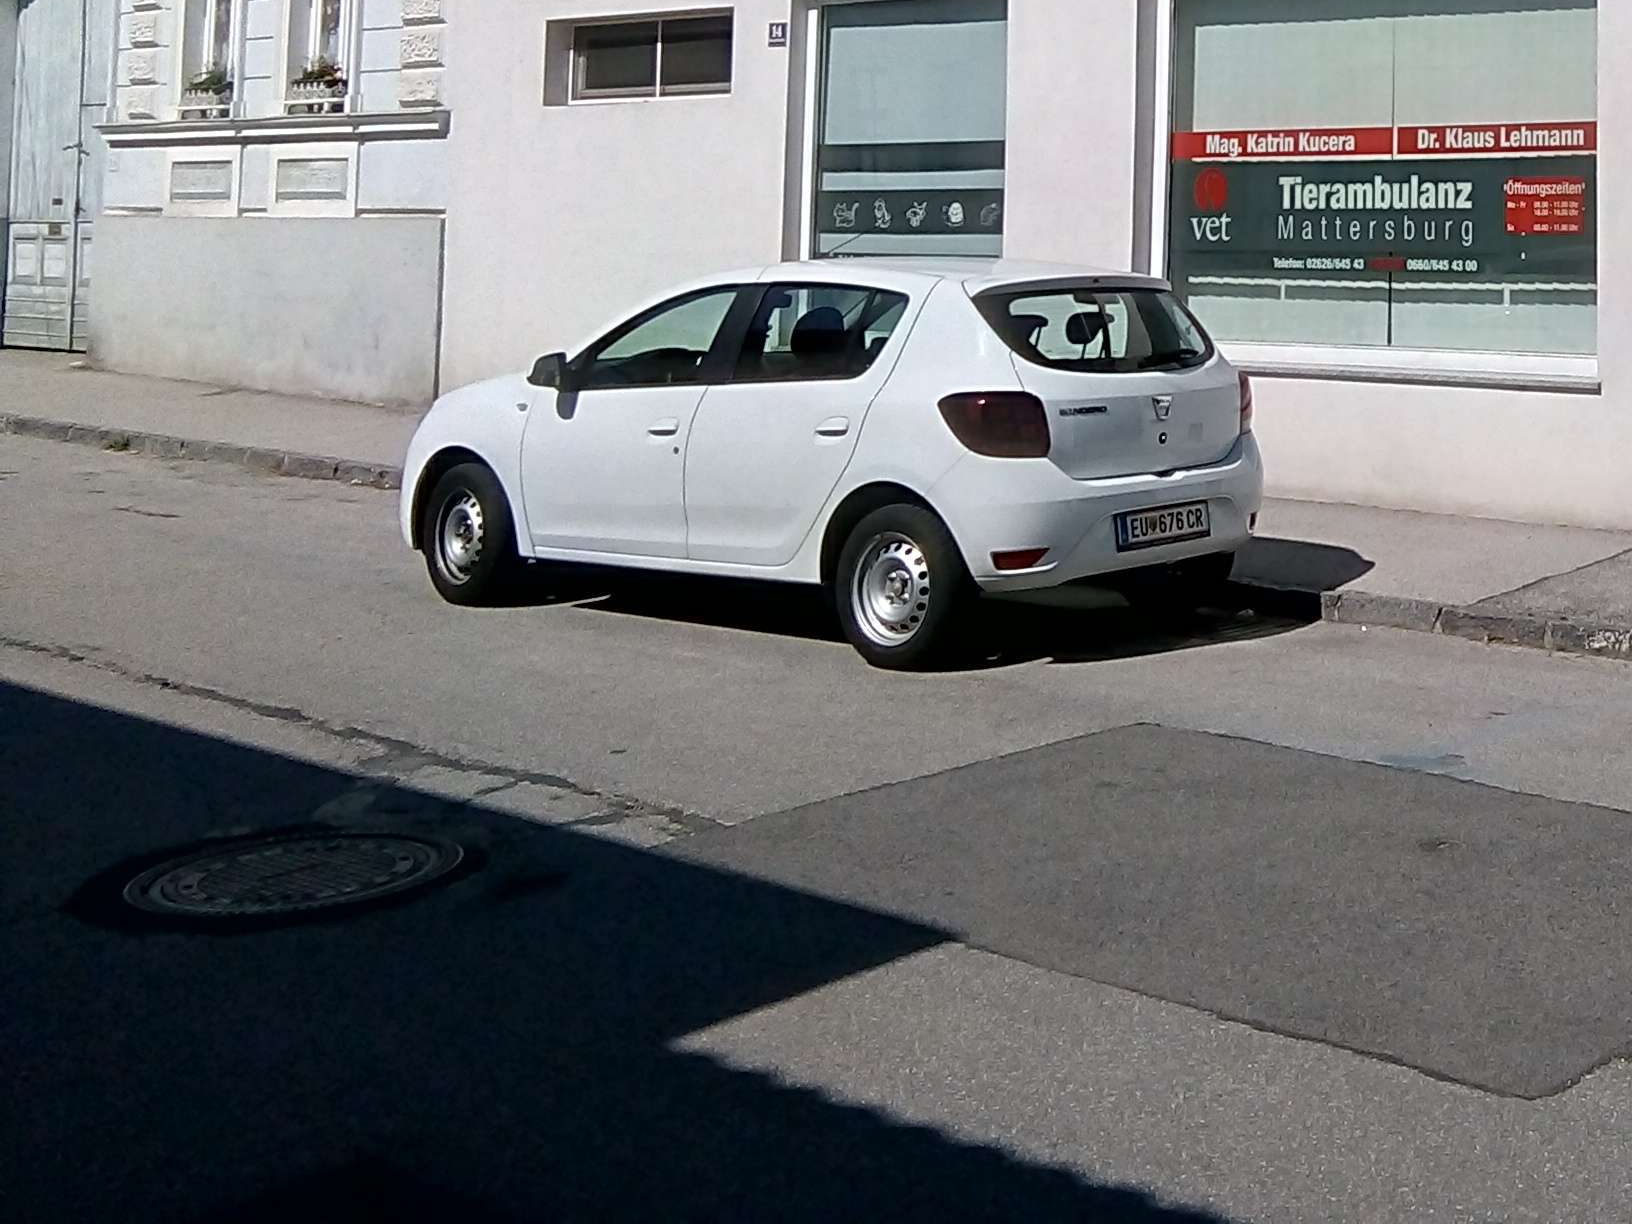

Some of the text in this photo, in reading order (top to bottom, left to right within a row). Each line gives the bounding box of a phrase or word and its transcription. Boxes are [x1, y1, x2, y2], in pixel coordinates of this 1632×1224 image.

[771, 25, 782, 37] 14
[1205, 131, 1355, 157] Mag. Katrin Kucera
[1417, 127, 1585, 149] Dr. Klaus Lehmann
[1278, 175, 1473, 210] Tierambulanz
[1506, 179, 1582, 197] Öffnungszeiten
[1190, 211, 1232, 241] vet
[1277, 215, 1473, 247] Mattersburg
[1273, 257, 1304, 270] Telefon:
[1353, 258, 1365, 270] 43
[1451, 260, 1464, 272] 43
[1465, 260, 1478, 272] 00
[1130, 508, 1204, 538] EU 676 CR
